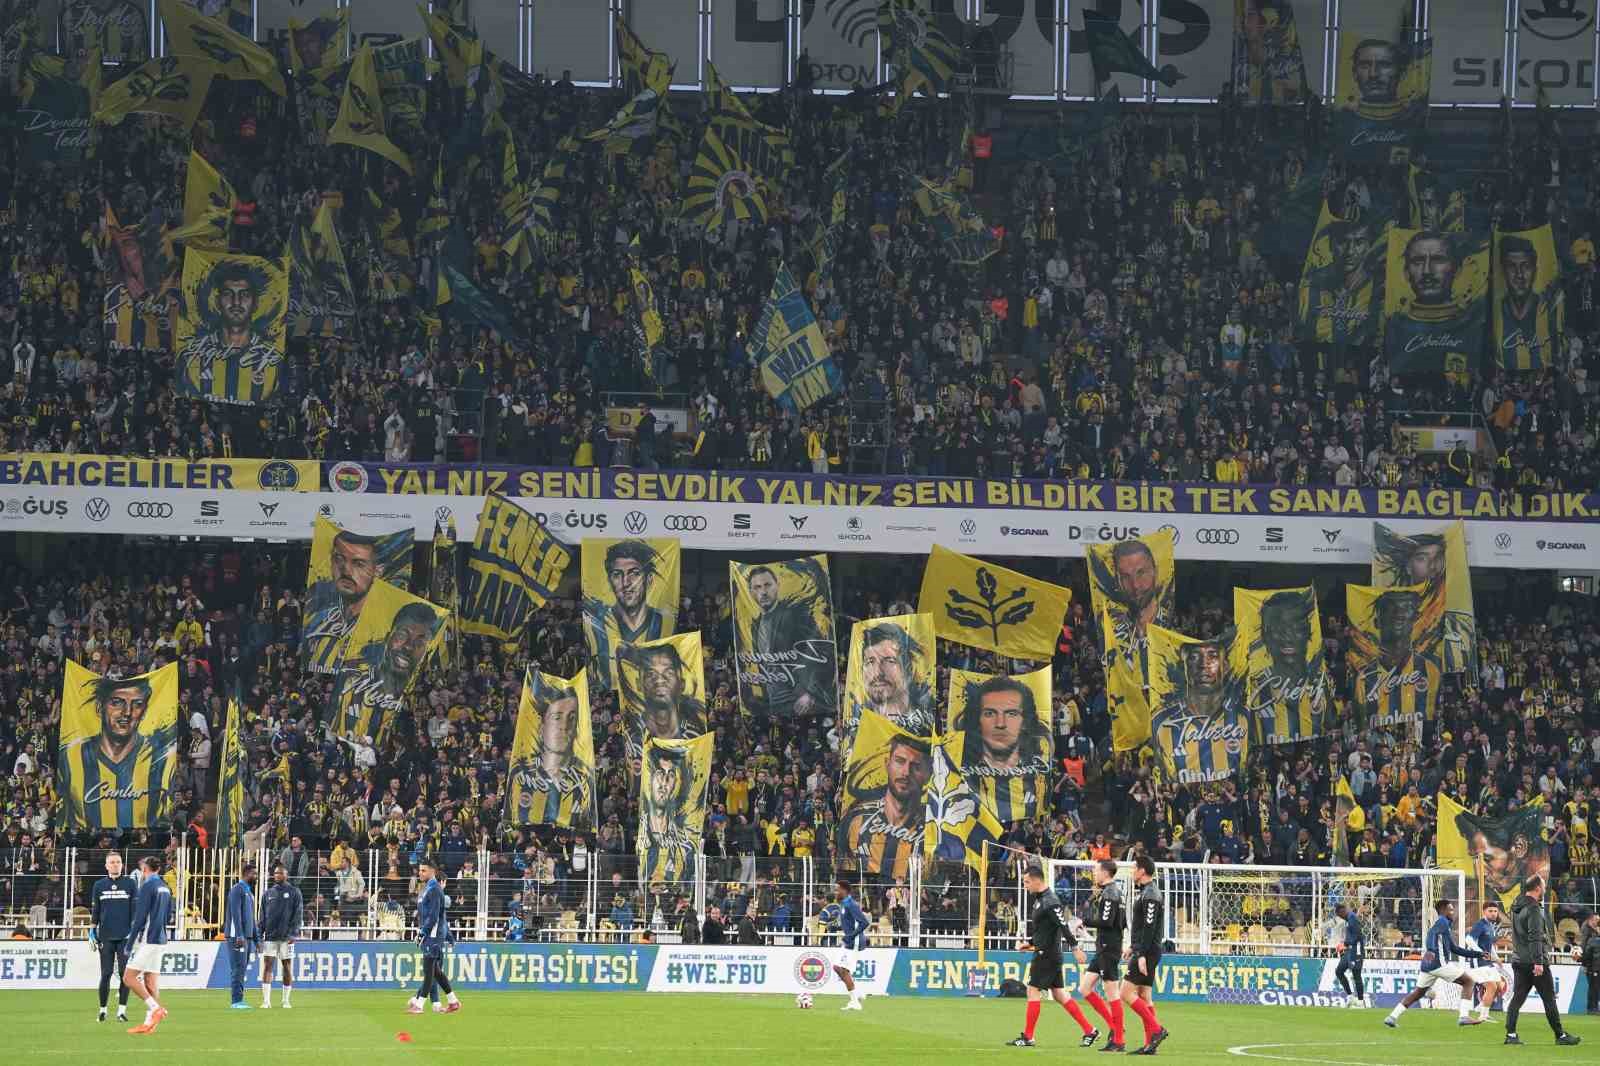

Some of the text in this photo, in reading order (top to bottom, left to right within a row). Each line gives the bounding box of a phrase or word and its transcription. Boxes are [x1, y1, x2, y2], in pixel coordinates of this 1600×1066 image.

[378, 468, 508, 497] YALNIZ
[518, 467, 601, 499] SENİ
[614, 470, 745, 502] SEVDİK
[756, 478, 882, 506] YALNIZ
[986, 478, 1105, 510] BİLDİK
[1115, 480, 1176, 512] BİR
[1185, 487, 1259, 513] TEK
[1269, 488, 1366, 514] SANA
[1011, 528, 1049, 536] SCANIA
[1547, 542, 1587, 550] SCANIA
[1156, 715, 1247, 749] Talisca
[667, 962, 767, 984] #WE_FBU
[1259, 989, 1372, 1009] Chobai
